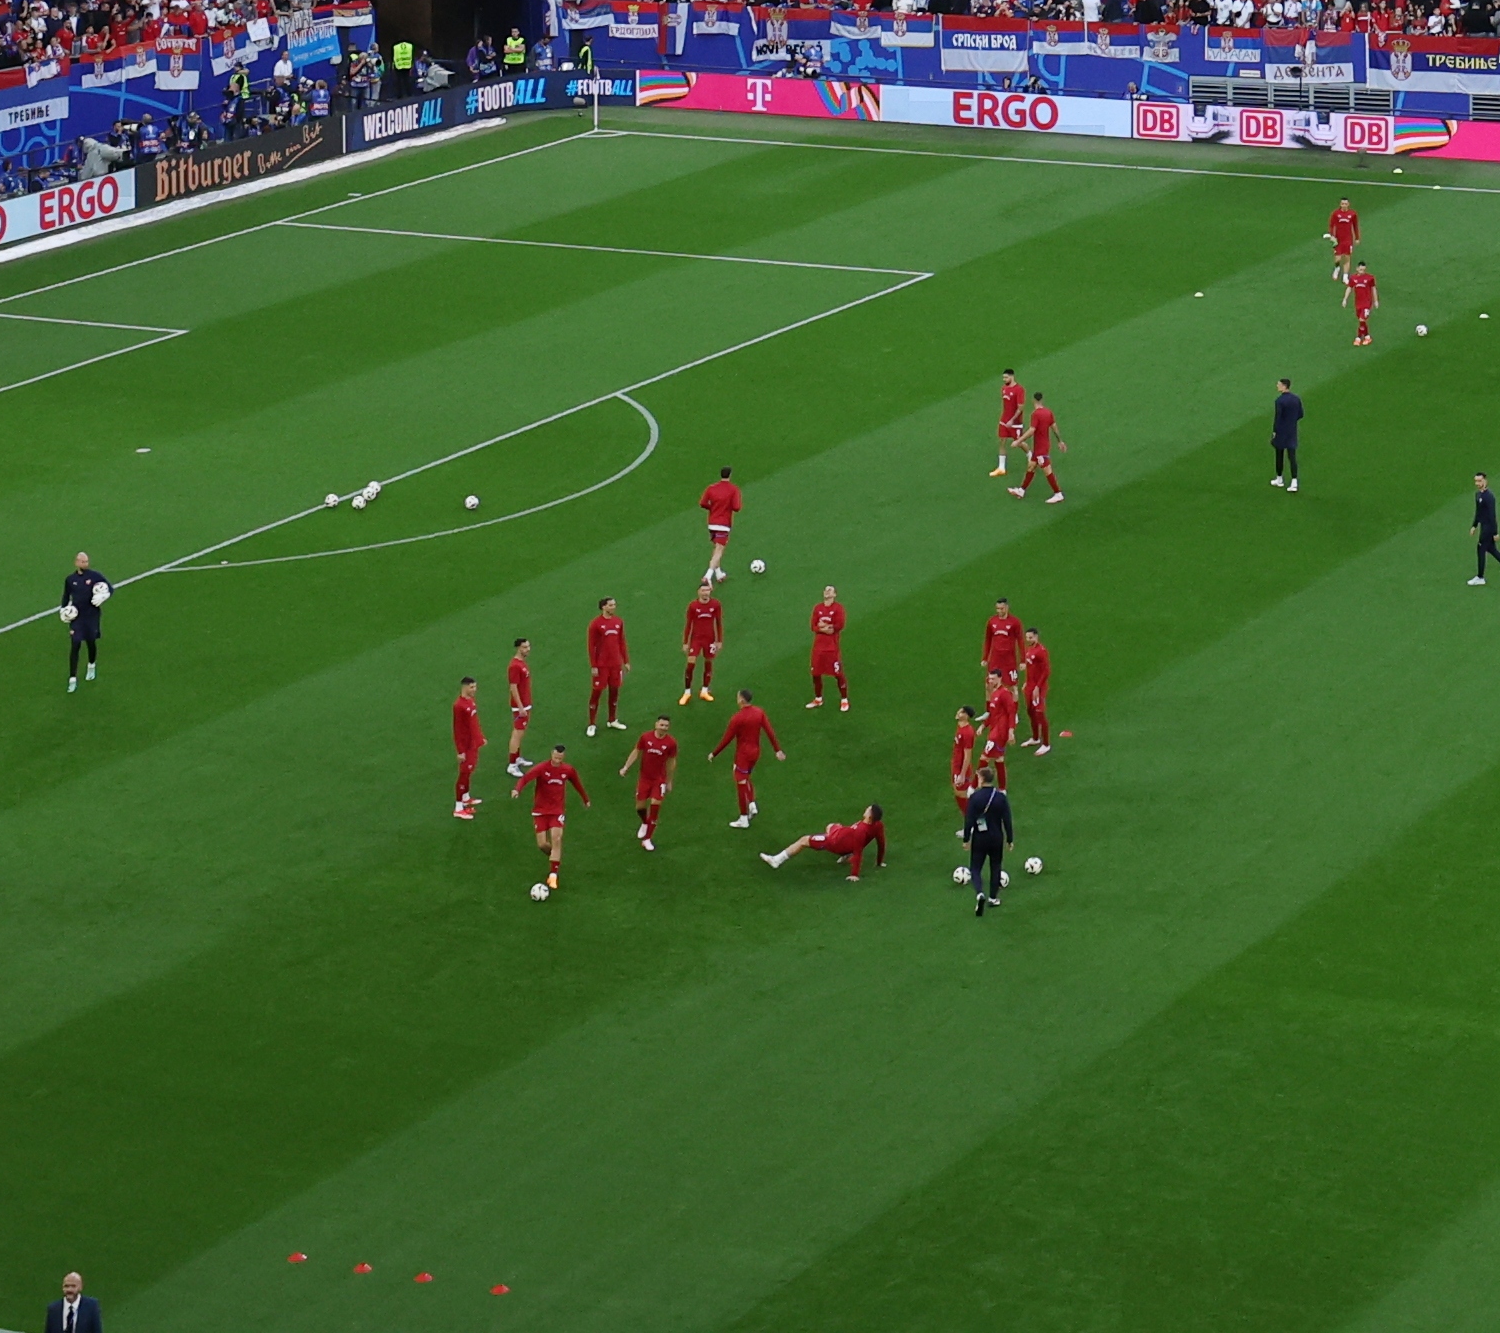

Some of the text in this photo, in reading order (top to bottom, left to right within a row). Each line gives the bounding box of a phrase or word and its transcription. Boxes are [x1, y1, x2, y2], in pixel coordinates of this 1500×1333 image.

[991, 34, 1018, 50] БРОД
[8, 104, 50, 125] ТРЕБИЊЕ
[465, 77, 547, 116] #FOOTBALL
[952, 91, 1058, 130] ERGO
[363, 103, 419, 142] WELCOME
[1142, 109, 1175, 132] DB
[1244, 115, 1277, 139] DB
[1350, 122, 1384, 147] DB
[257, 123, 323, 174] Bitte ein Bit
[154, 149, 252, 201] Bitburger
[39, 173, 119, 231] ERGO
